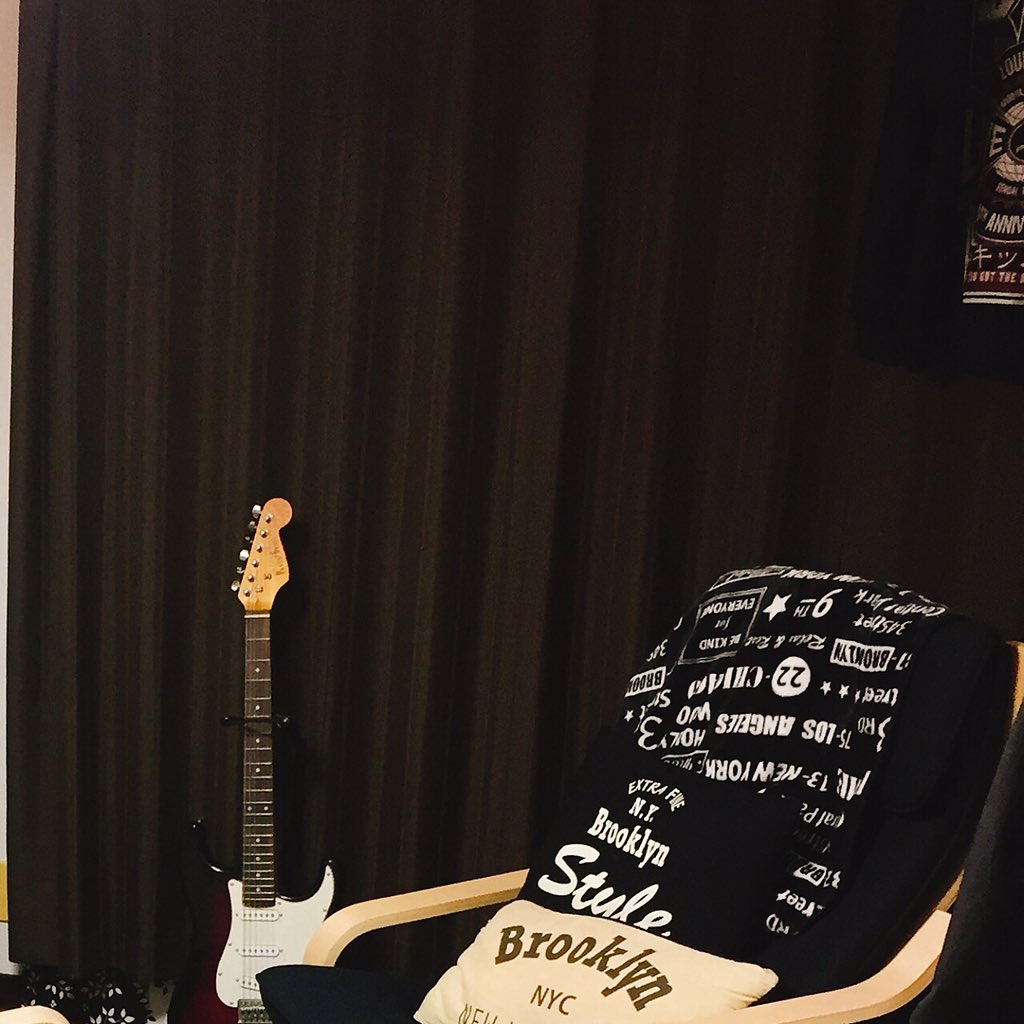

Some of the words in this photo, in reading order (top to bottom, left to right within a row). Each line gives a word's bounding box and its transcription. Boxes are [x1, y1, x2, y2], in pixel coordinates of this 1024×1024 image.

[699, 636, 728, 650] KIND
[777, 666, 806, 688] 22
[628, 779, 668, 795] EXTRA
[587, 807, 670, 868] Brooklyn
[494, 924, 674, 1012] Brooklyn
[530, 984, 577, 1016] NYC
